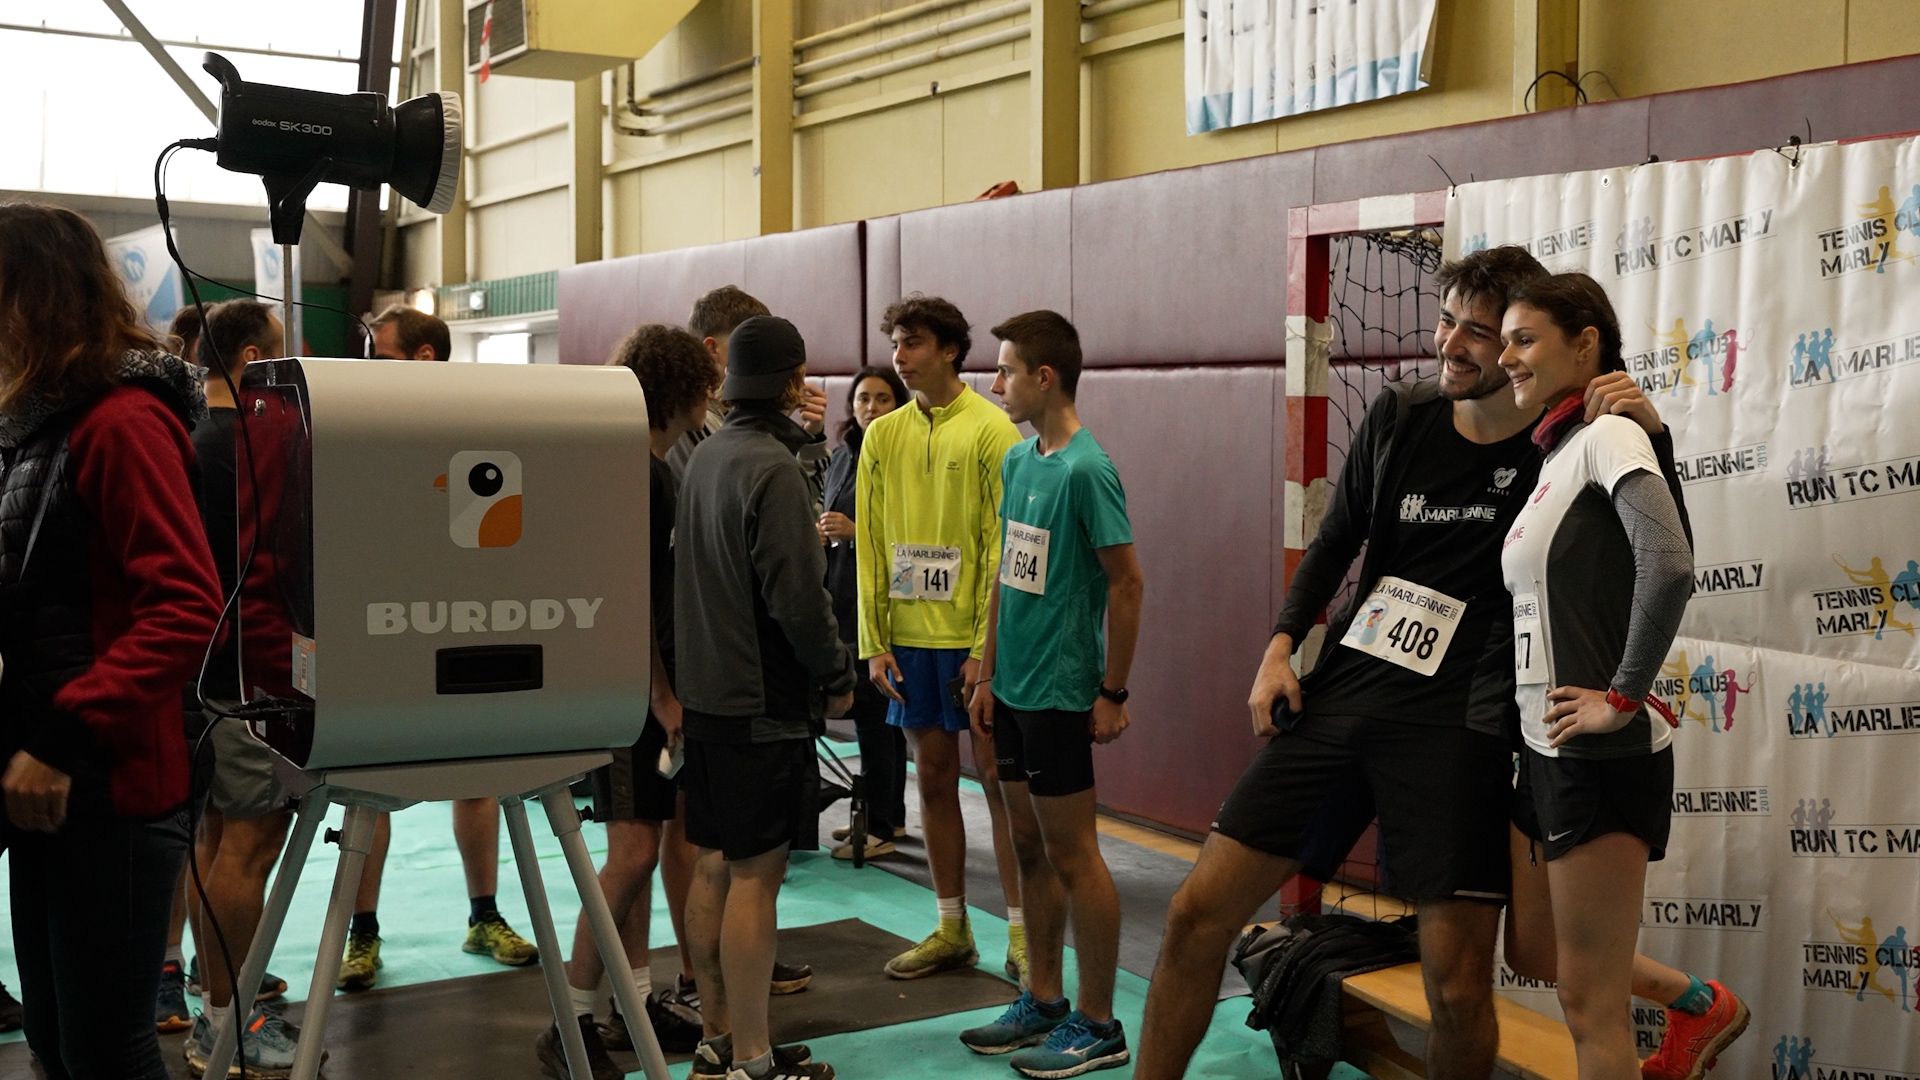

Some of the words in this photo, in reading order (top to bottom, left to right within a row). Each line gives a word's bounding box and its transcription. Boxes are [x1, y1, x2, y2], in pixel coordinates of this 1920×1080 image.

[279, 120, 333, 136] SK300
[1615, 244, 1657, 275] RUN
[1664, 235, 1692, 261] TC
[1699, 209, 1773, 253] MARLY
[1818, 218, 1888, 252] TENNIS
[1820, 241, 1890, 277] MARLY
[1625, 347, 1681, 374] TENNIS
[1686, 336, 1729, 361] CLUB
[1789, 360, 1821, 386] LA
[1786, 475, 1837, 505] RUN
[1842, 469, 1880, 496] TC
[923, 568, 949, 592] 141
[1014, 550, 1038, 582] 684
[1693, 563, 1763, 593] MARLY
[1385, 584, 1451, 618] MARLIENNE
[1813, 586, 1885, 611] TENNIS
[1890, 582, 1920, 602] CL
[366, 597, 604, 636] BURDDY
[1816, 610, 1888, 635] MARLY
[1387, 616, 1439, 660] 408
[1688, 674, 1728, 695] CLUB
[1787, 712, 1819, 735] LA
[1790, 829, 1837, 853] RUN
[1844, 829, 1878, 853] TC
[1650, 901, 1679, 924] TC
[1685, 902, 1761, 927] MARLY
[1803, 944, 1868, 965] TENNIS
[1875, 947, 1920, 969] CLUB
[1803, 968, 1870, 991] MARLY
